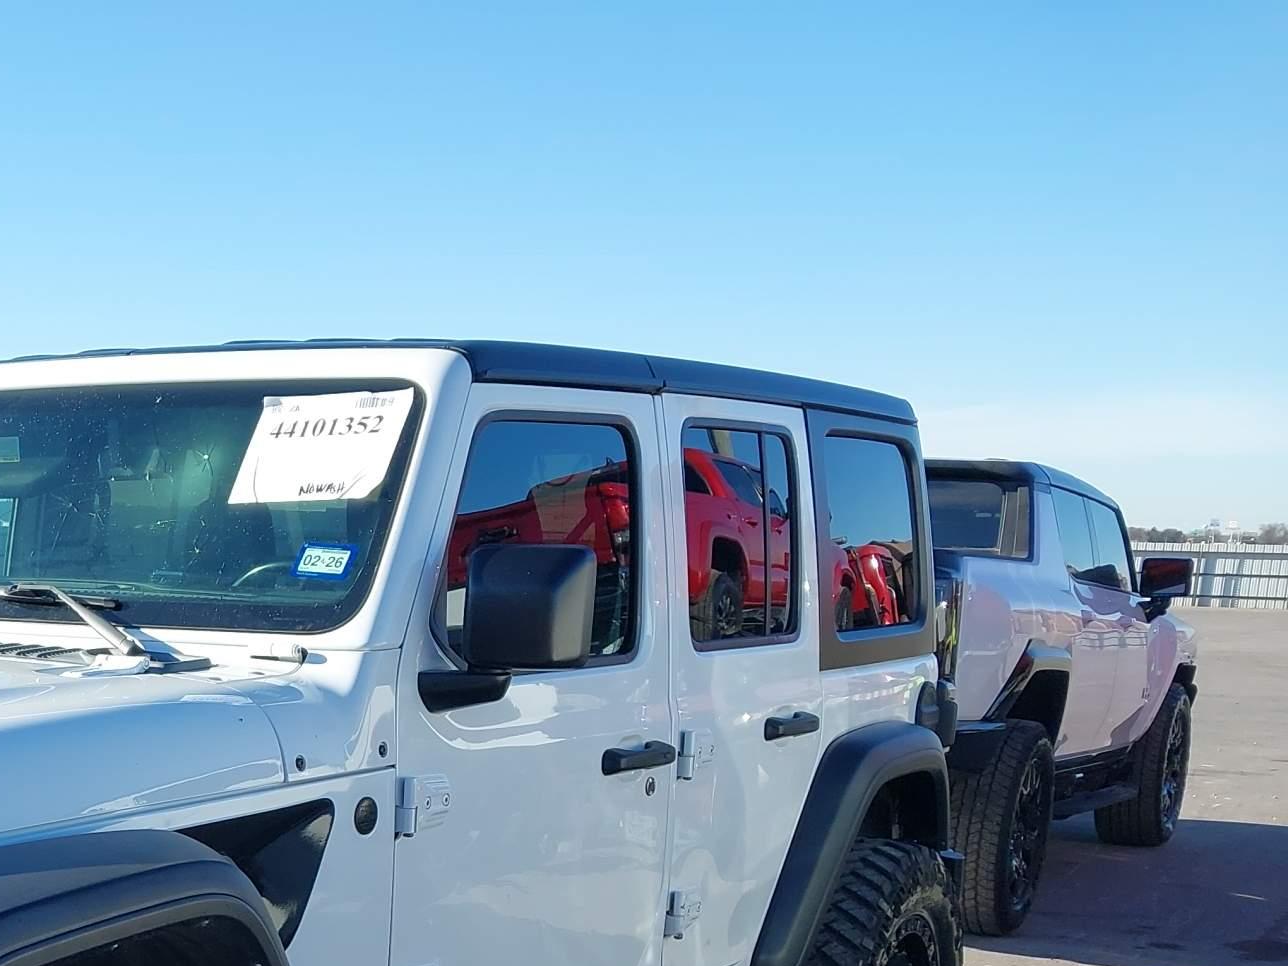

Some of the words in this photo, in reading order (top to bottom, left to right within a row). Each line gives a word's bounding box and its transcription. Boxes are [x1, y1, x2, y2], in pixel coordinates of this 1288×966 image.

[270, 415, 384, 438] 44101352
[303, 554, 321, 567] 02
[325, 556, 345, 569] 26
